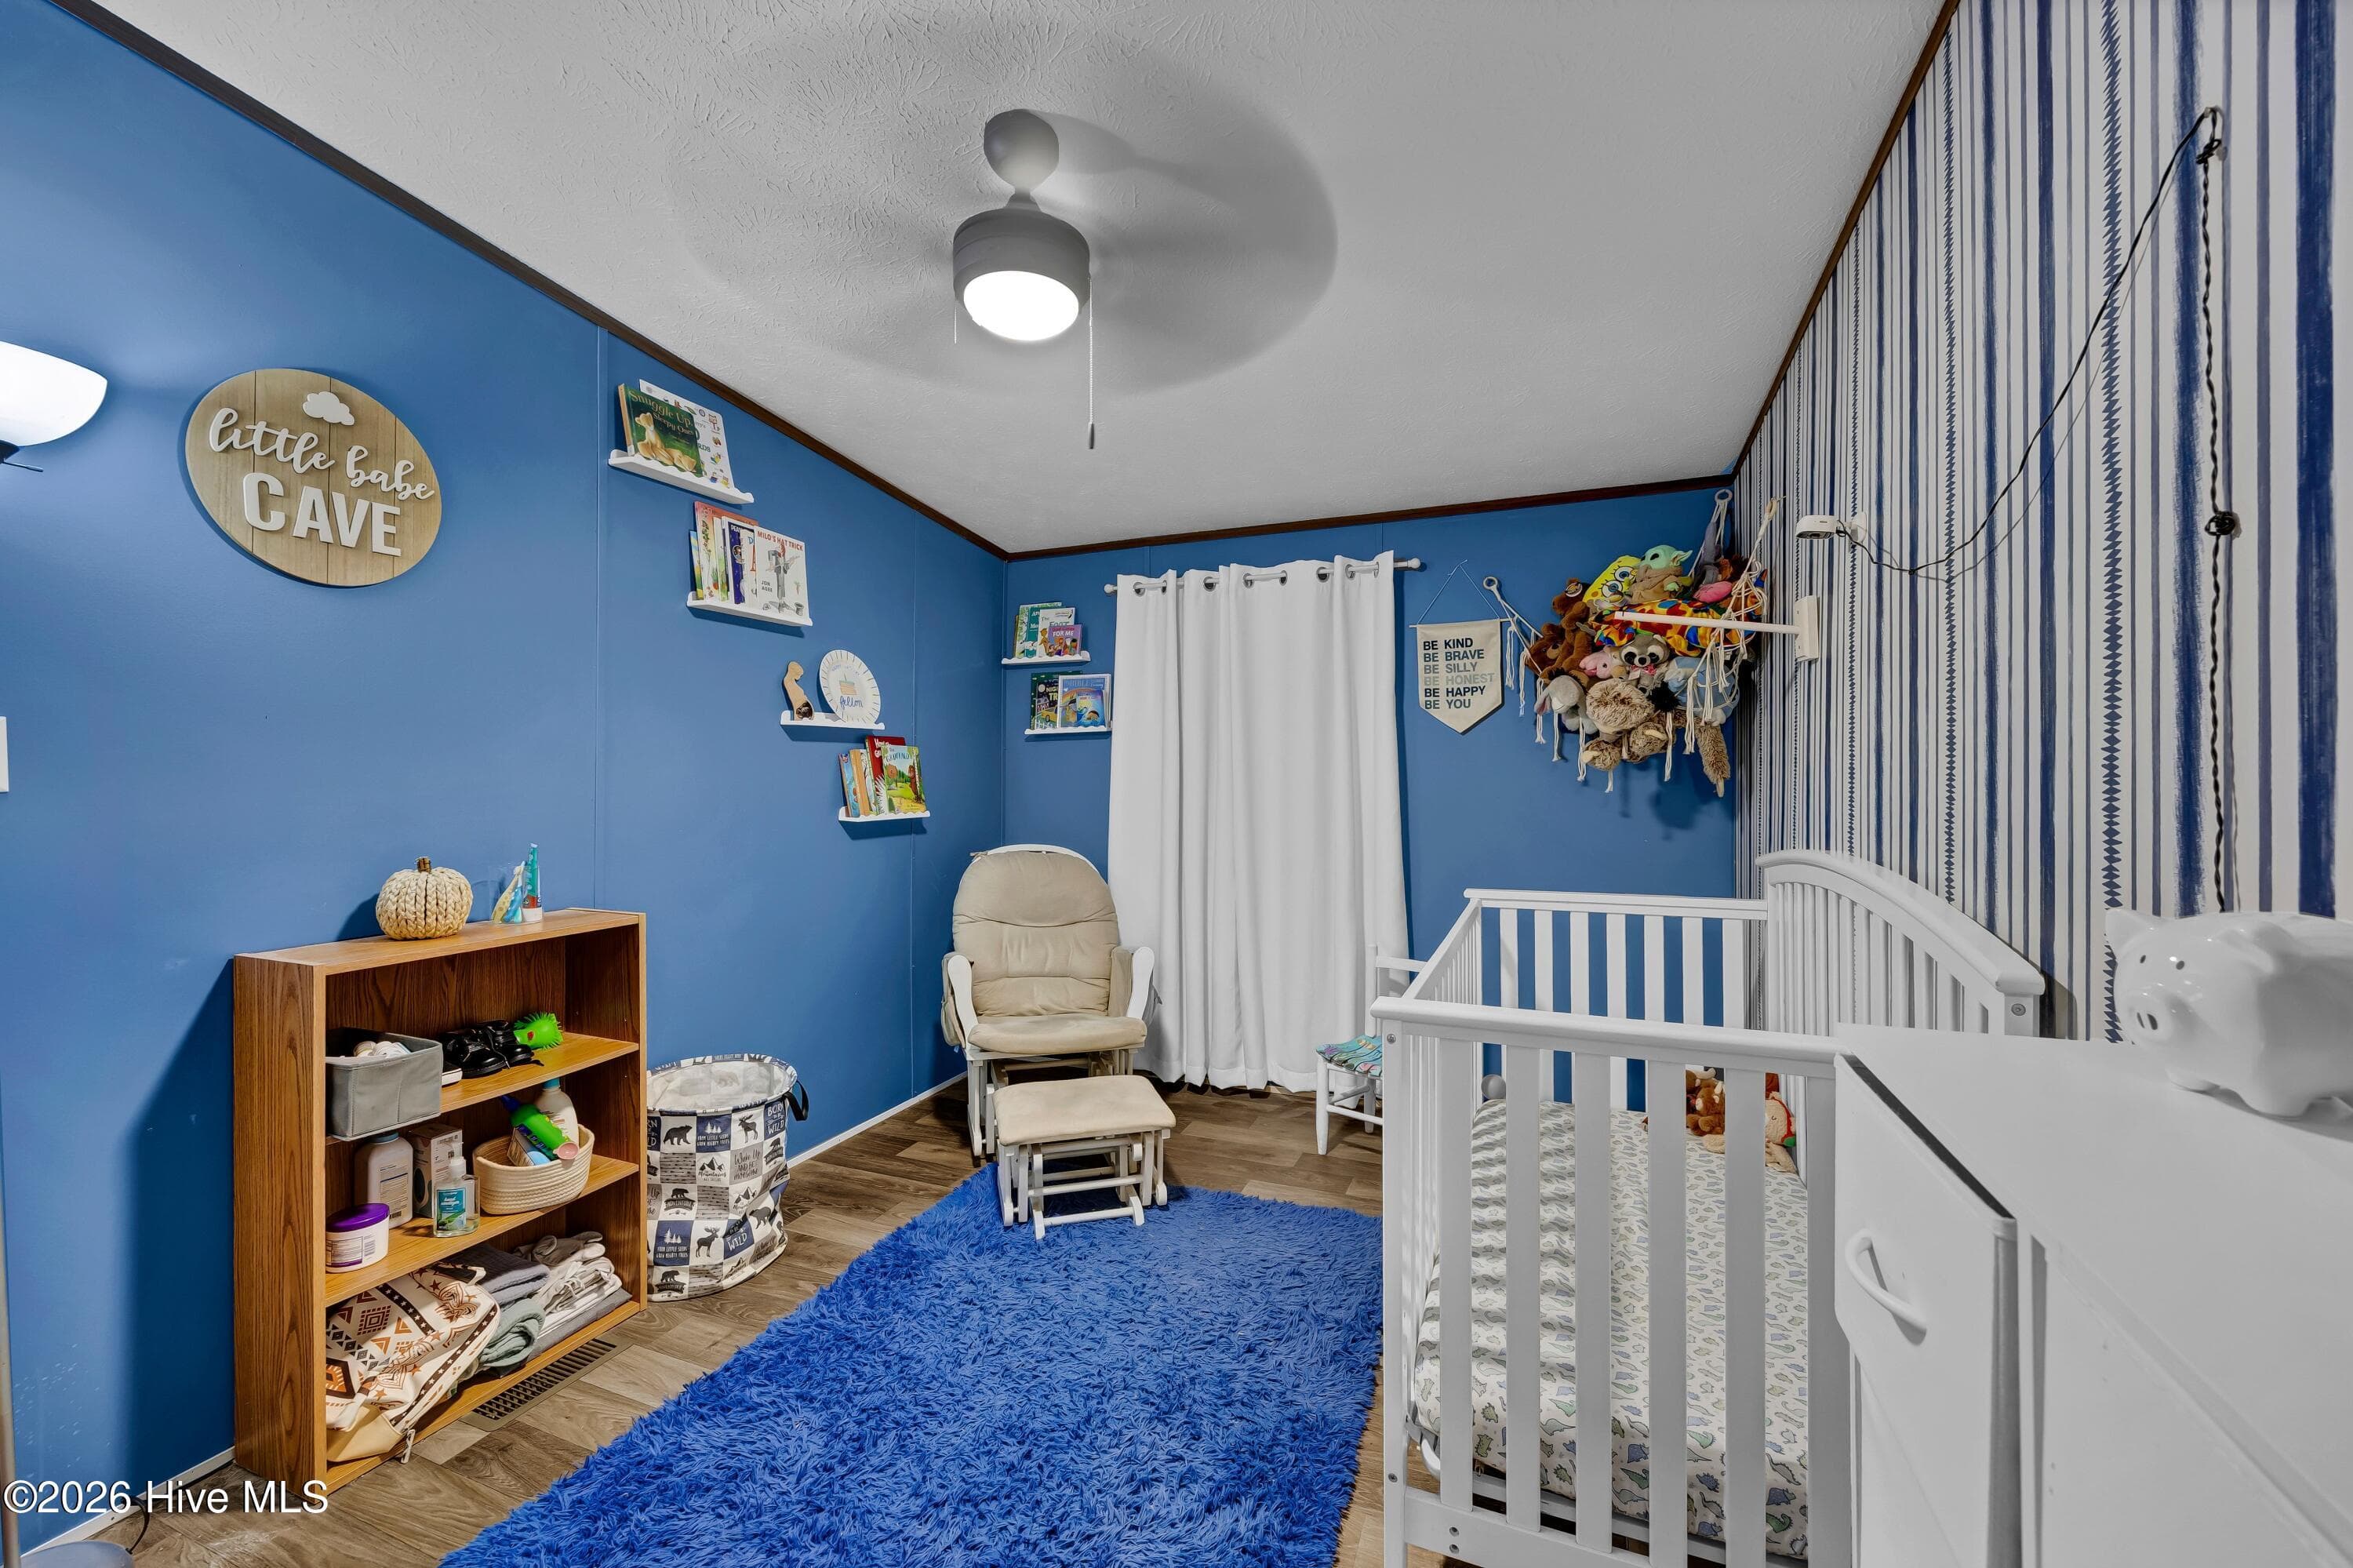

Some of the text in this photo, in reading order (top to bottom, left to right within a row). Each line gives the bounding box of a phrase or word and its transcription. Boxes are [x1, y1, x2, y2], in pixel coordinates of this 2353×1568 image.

[629, 391, 674, 417] Snuggle
[209, 407, 435, 500] little babe
[242, 472, 402, 557] CAVE
[757, 530, 776, 542] MILO'S
[776, 537, 787, 547] HAT
[788, 541, 803, 551] TRICK
[1423, 638, 1473, 650] BE KIND
[1424, 649, 1485, 662] BE BRAVE
[1424, 662, 1478, 674] BE SILLY
[1424, 673, 1494, 686] BE HONEST
[1424, 686, 1486, 697] BE HAPPY
[1424, 699, 1471, 709] BE YOU
[768, 1120, 784, 1135] WILD
[727, 1232, 747, 1251] WILD
